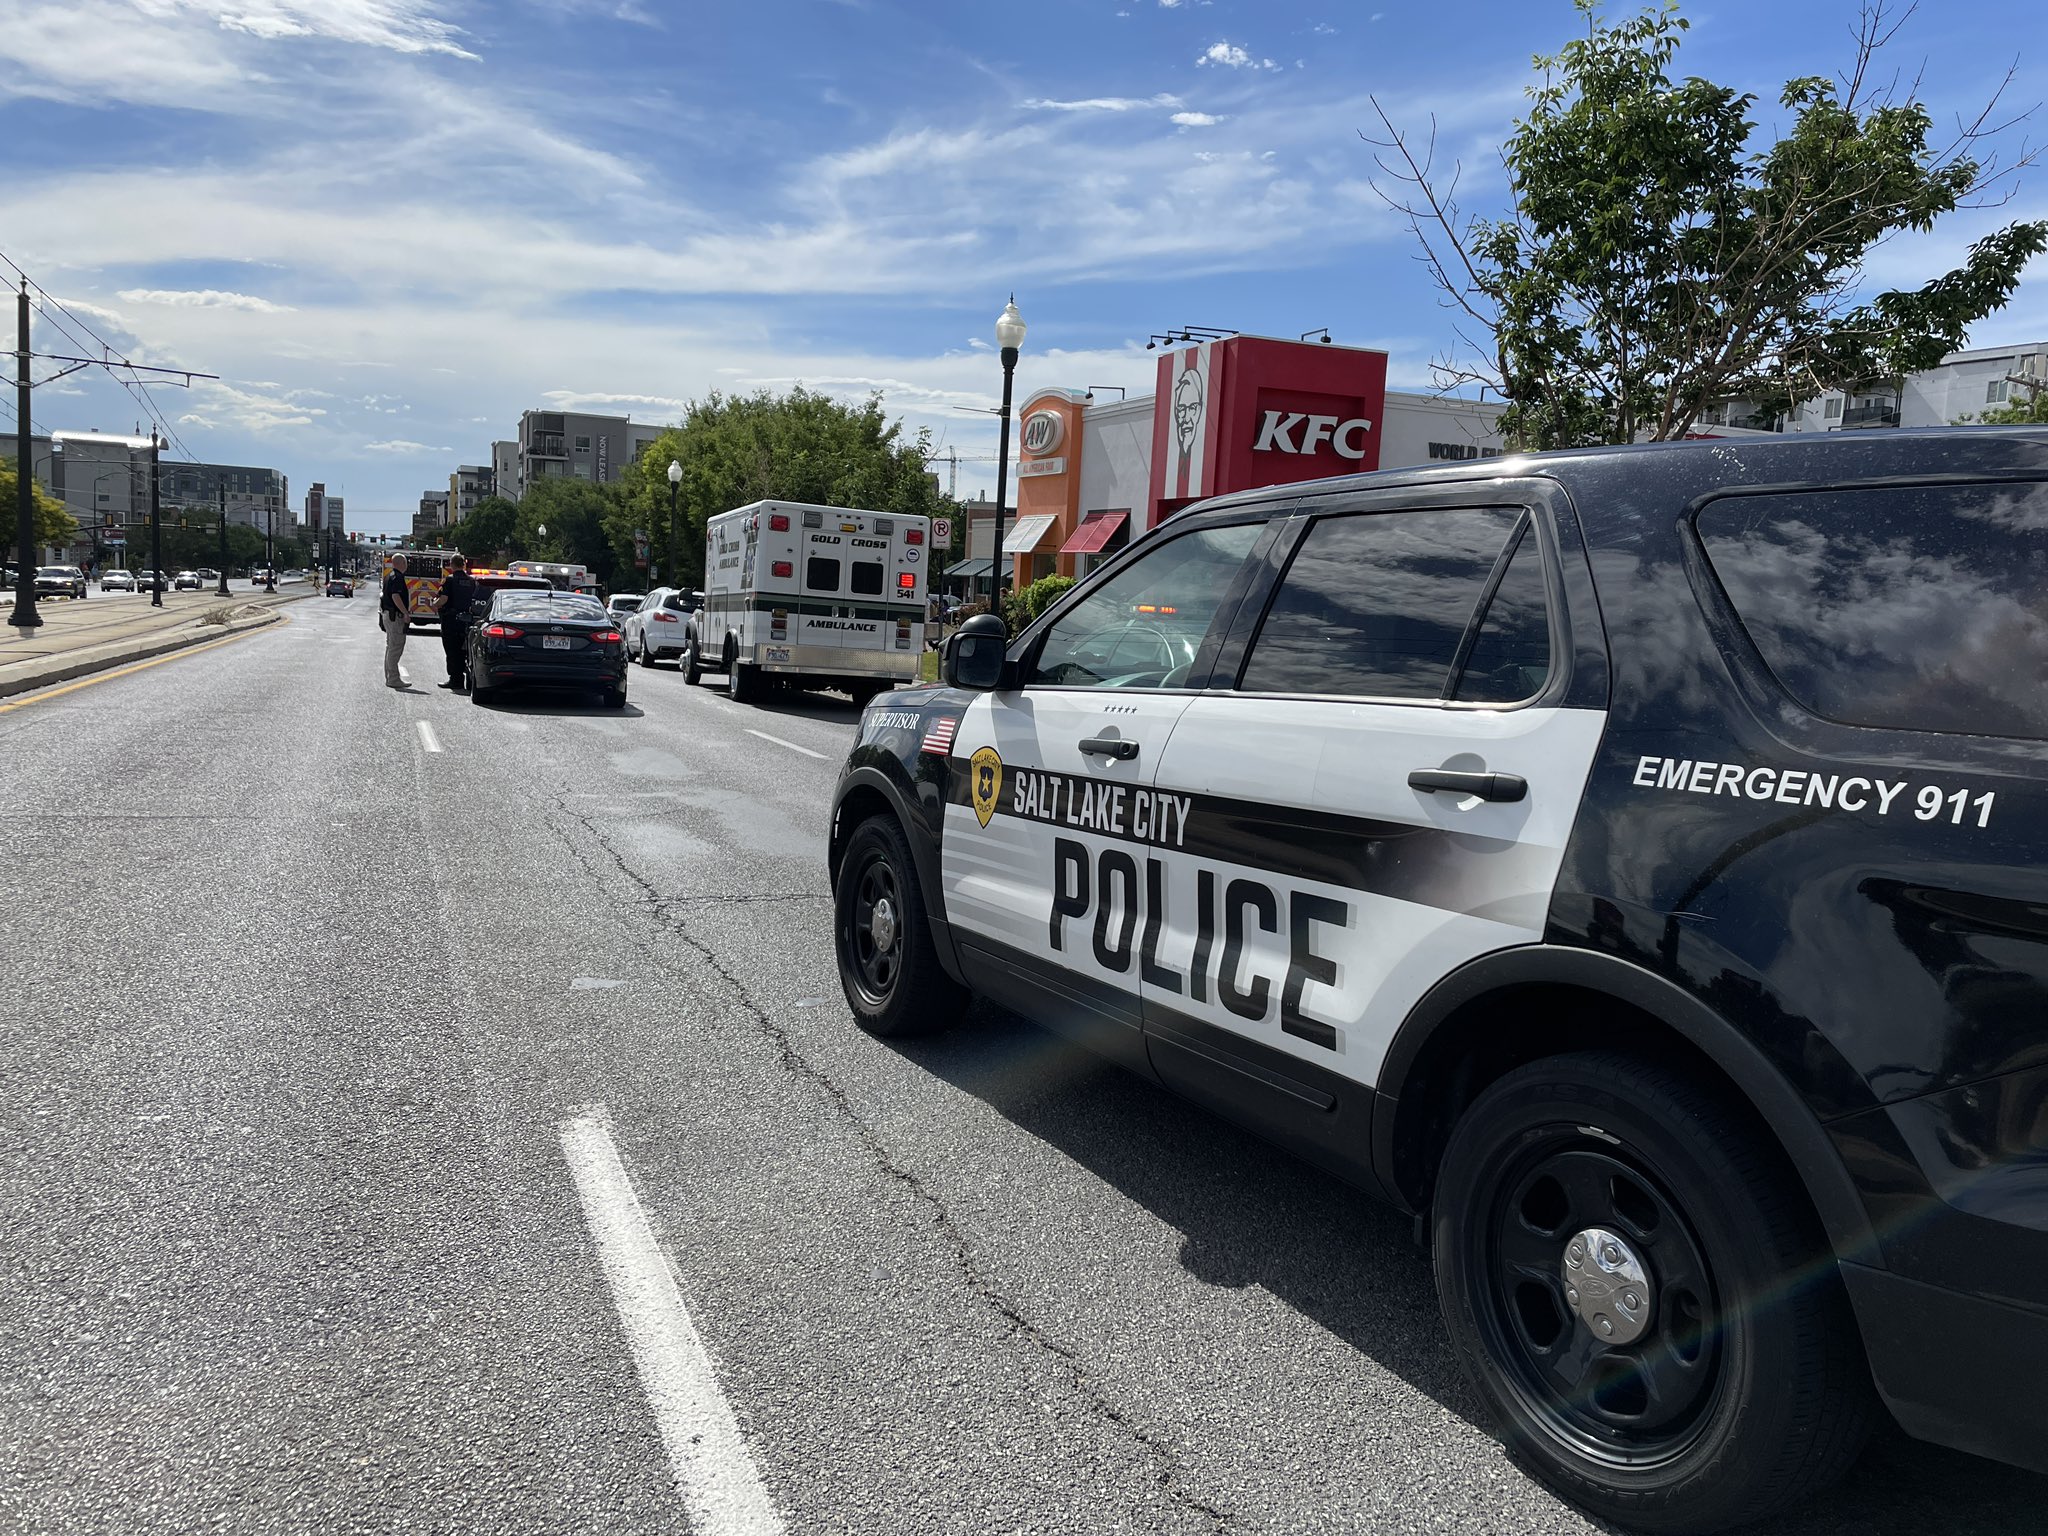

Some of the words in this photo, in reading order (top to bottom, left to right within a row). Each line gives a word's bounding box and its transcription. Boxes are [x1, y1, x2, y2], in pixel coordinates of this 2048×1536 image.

[1252, 410, 1373, 459] KFC
[599, 436, 607, 457] NOW
[1428, 442, 1478, 461] WORLD
[810, 534, 841, 545] GOLD
[850, 538, 888, 549] CROSS
[897, 589, 915, 599] 541
[807, 620, 877, 632] AMBULANCE
[868, 712, 921, 730] SUPERVISOR
[1632, 755, 1908, 815] EMERGENCY
[1914, 785, 1996, 828] 911
[1013, 771, 1062, 820] SALT
[1066, 779, 1127, 834] LAKE
[1133, 790, 1192, 846] CITY
[1050, 837, 1353, 1054] POLICE
